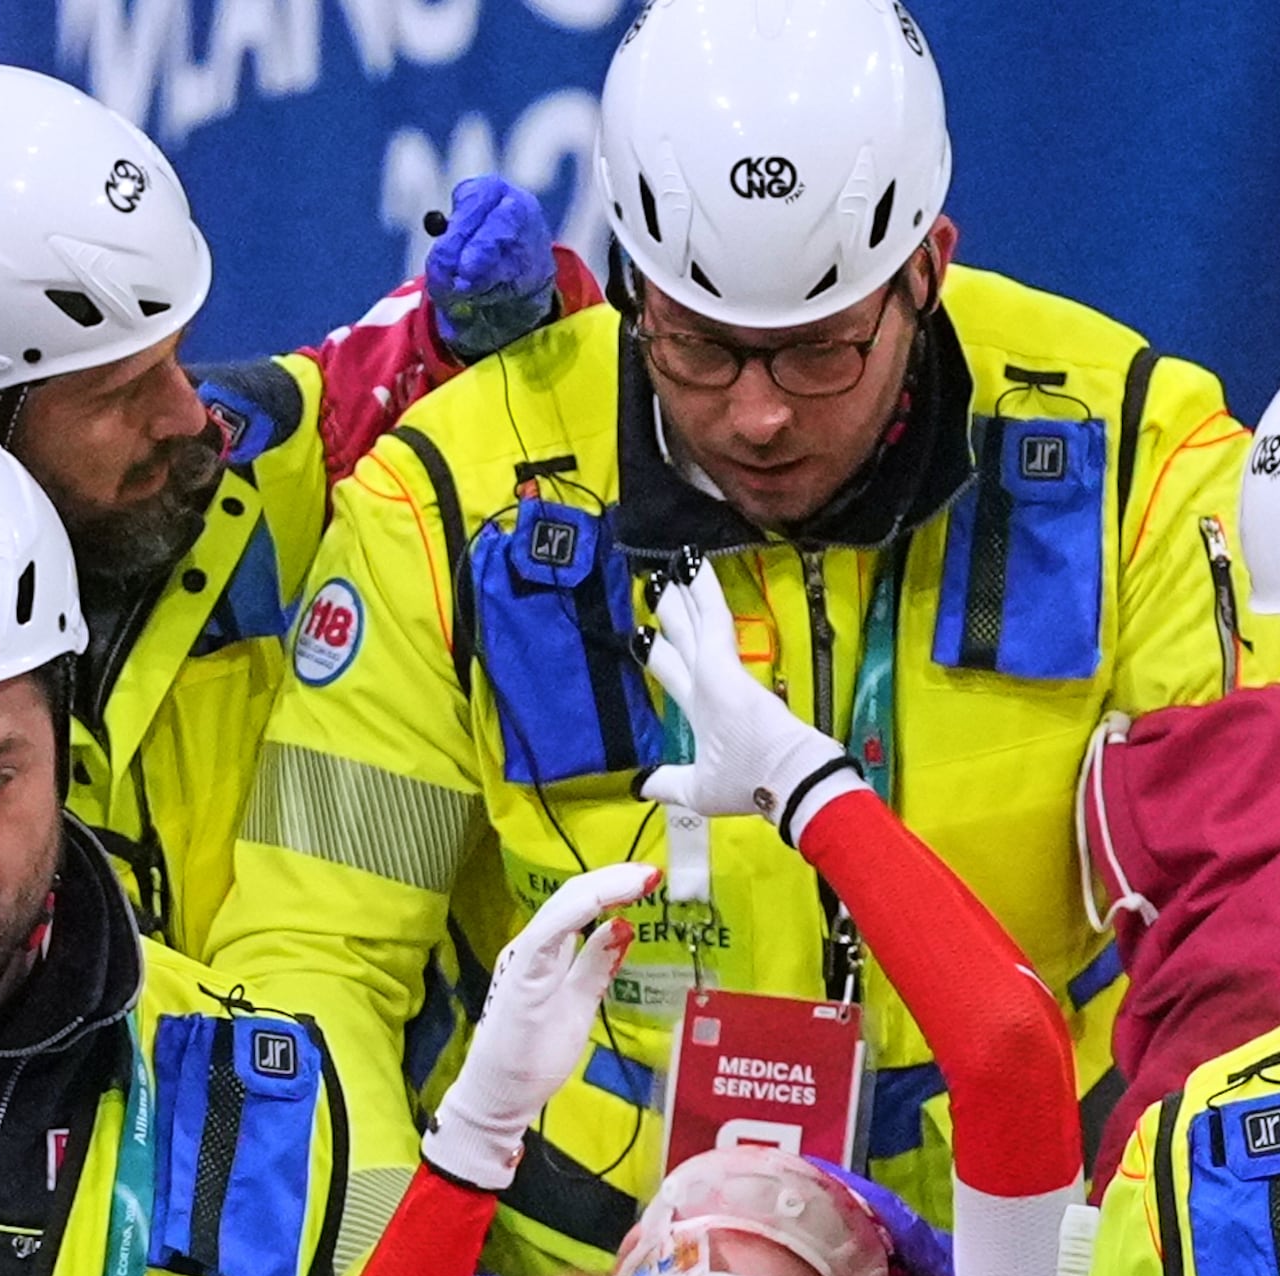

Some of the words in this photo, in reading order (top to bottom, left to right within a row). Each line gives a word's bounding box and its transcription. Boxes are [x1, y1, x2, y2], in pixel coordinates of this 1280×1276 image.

[304, 598, 353, 648] 118
[638, 921, 731, 949] ERVICE
[717, 1055, 816, 1085] MEDICAL
[712, 1076, 817, 1106] SERVICES
